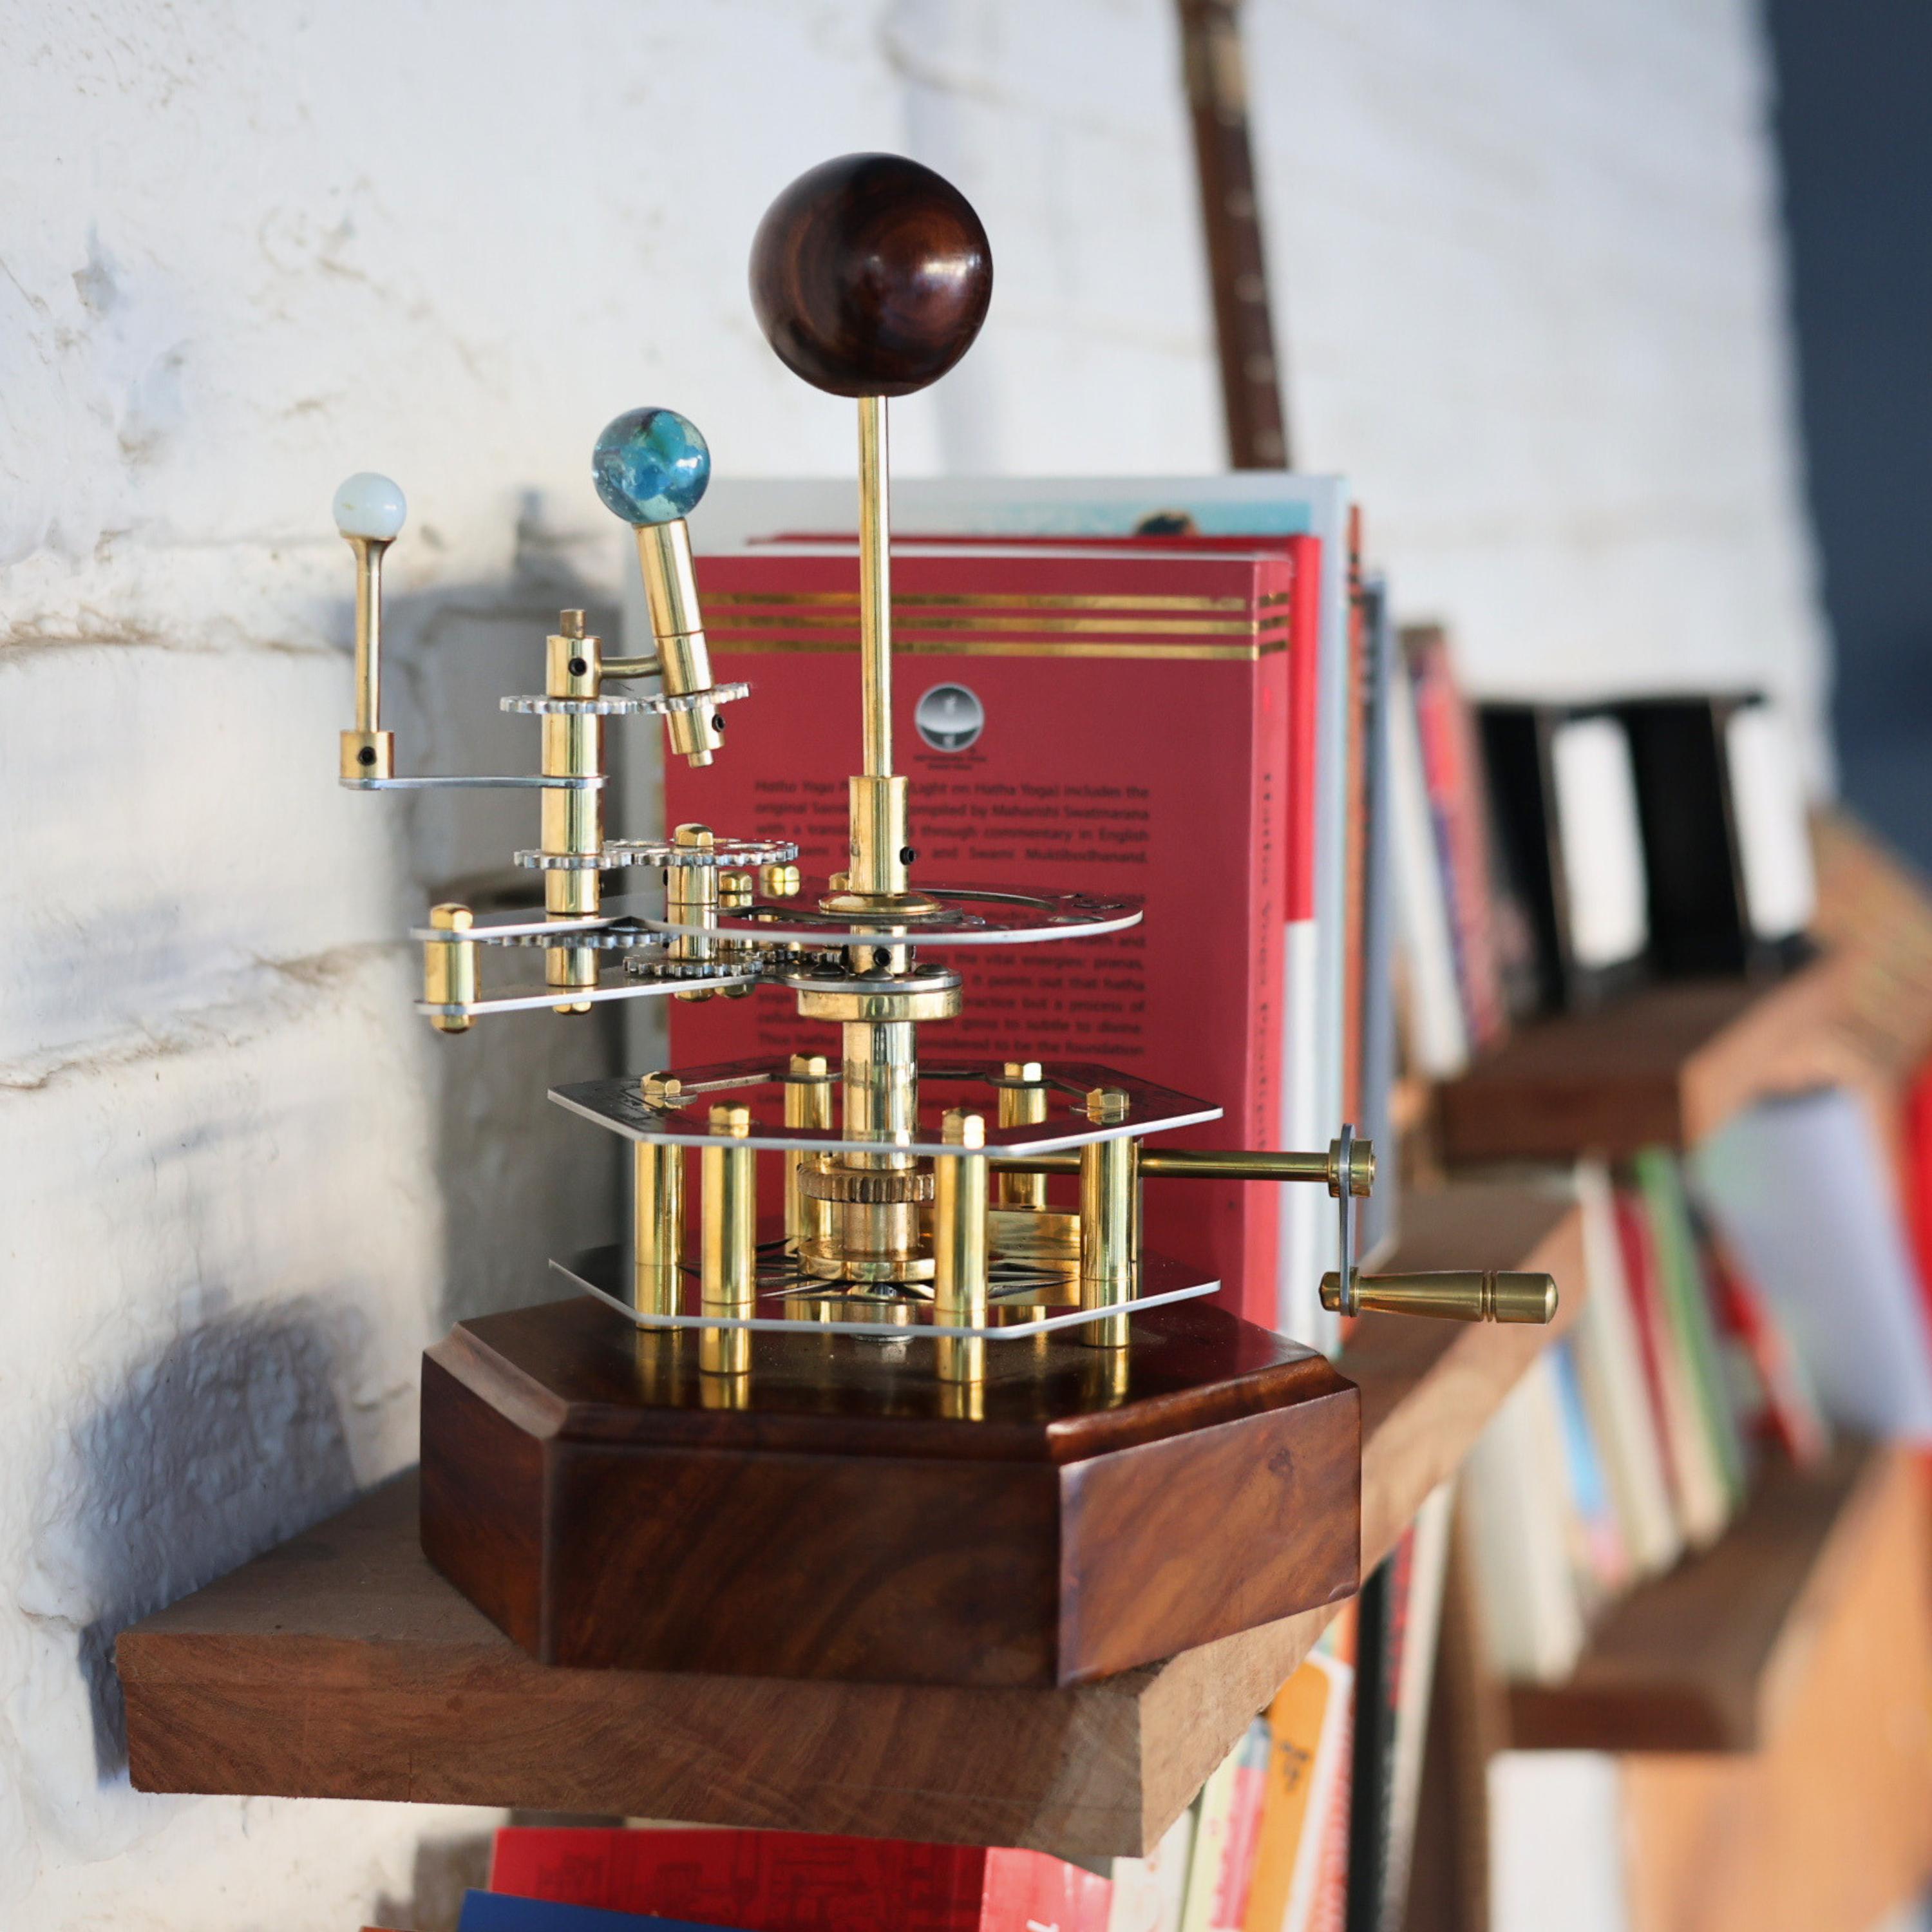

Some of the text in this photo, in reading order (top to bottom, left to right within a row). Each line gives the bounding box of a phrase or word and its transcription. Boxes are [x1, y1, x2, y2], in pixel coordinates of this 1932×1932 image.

[974, 783, 1017, 795] Hatha
[1065, 784, 1121, 797] includes
[1126, 785, 1150, 798] the
[1099, 827, 1150, 844] English
